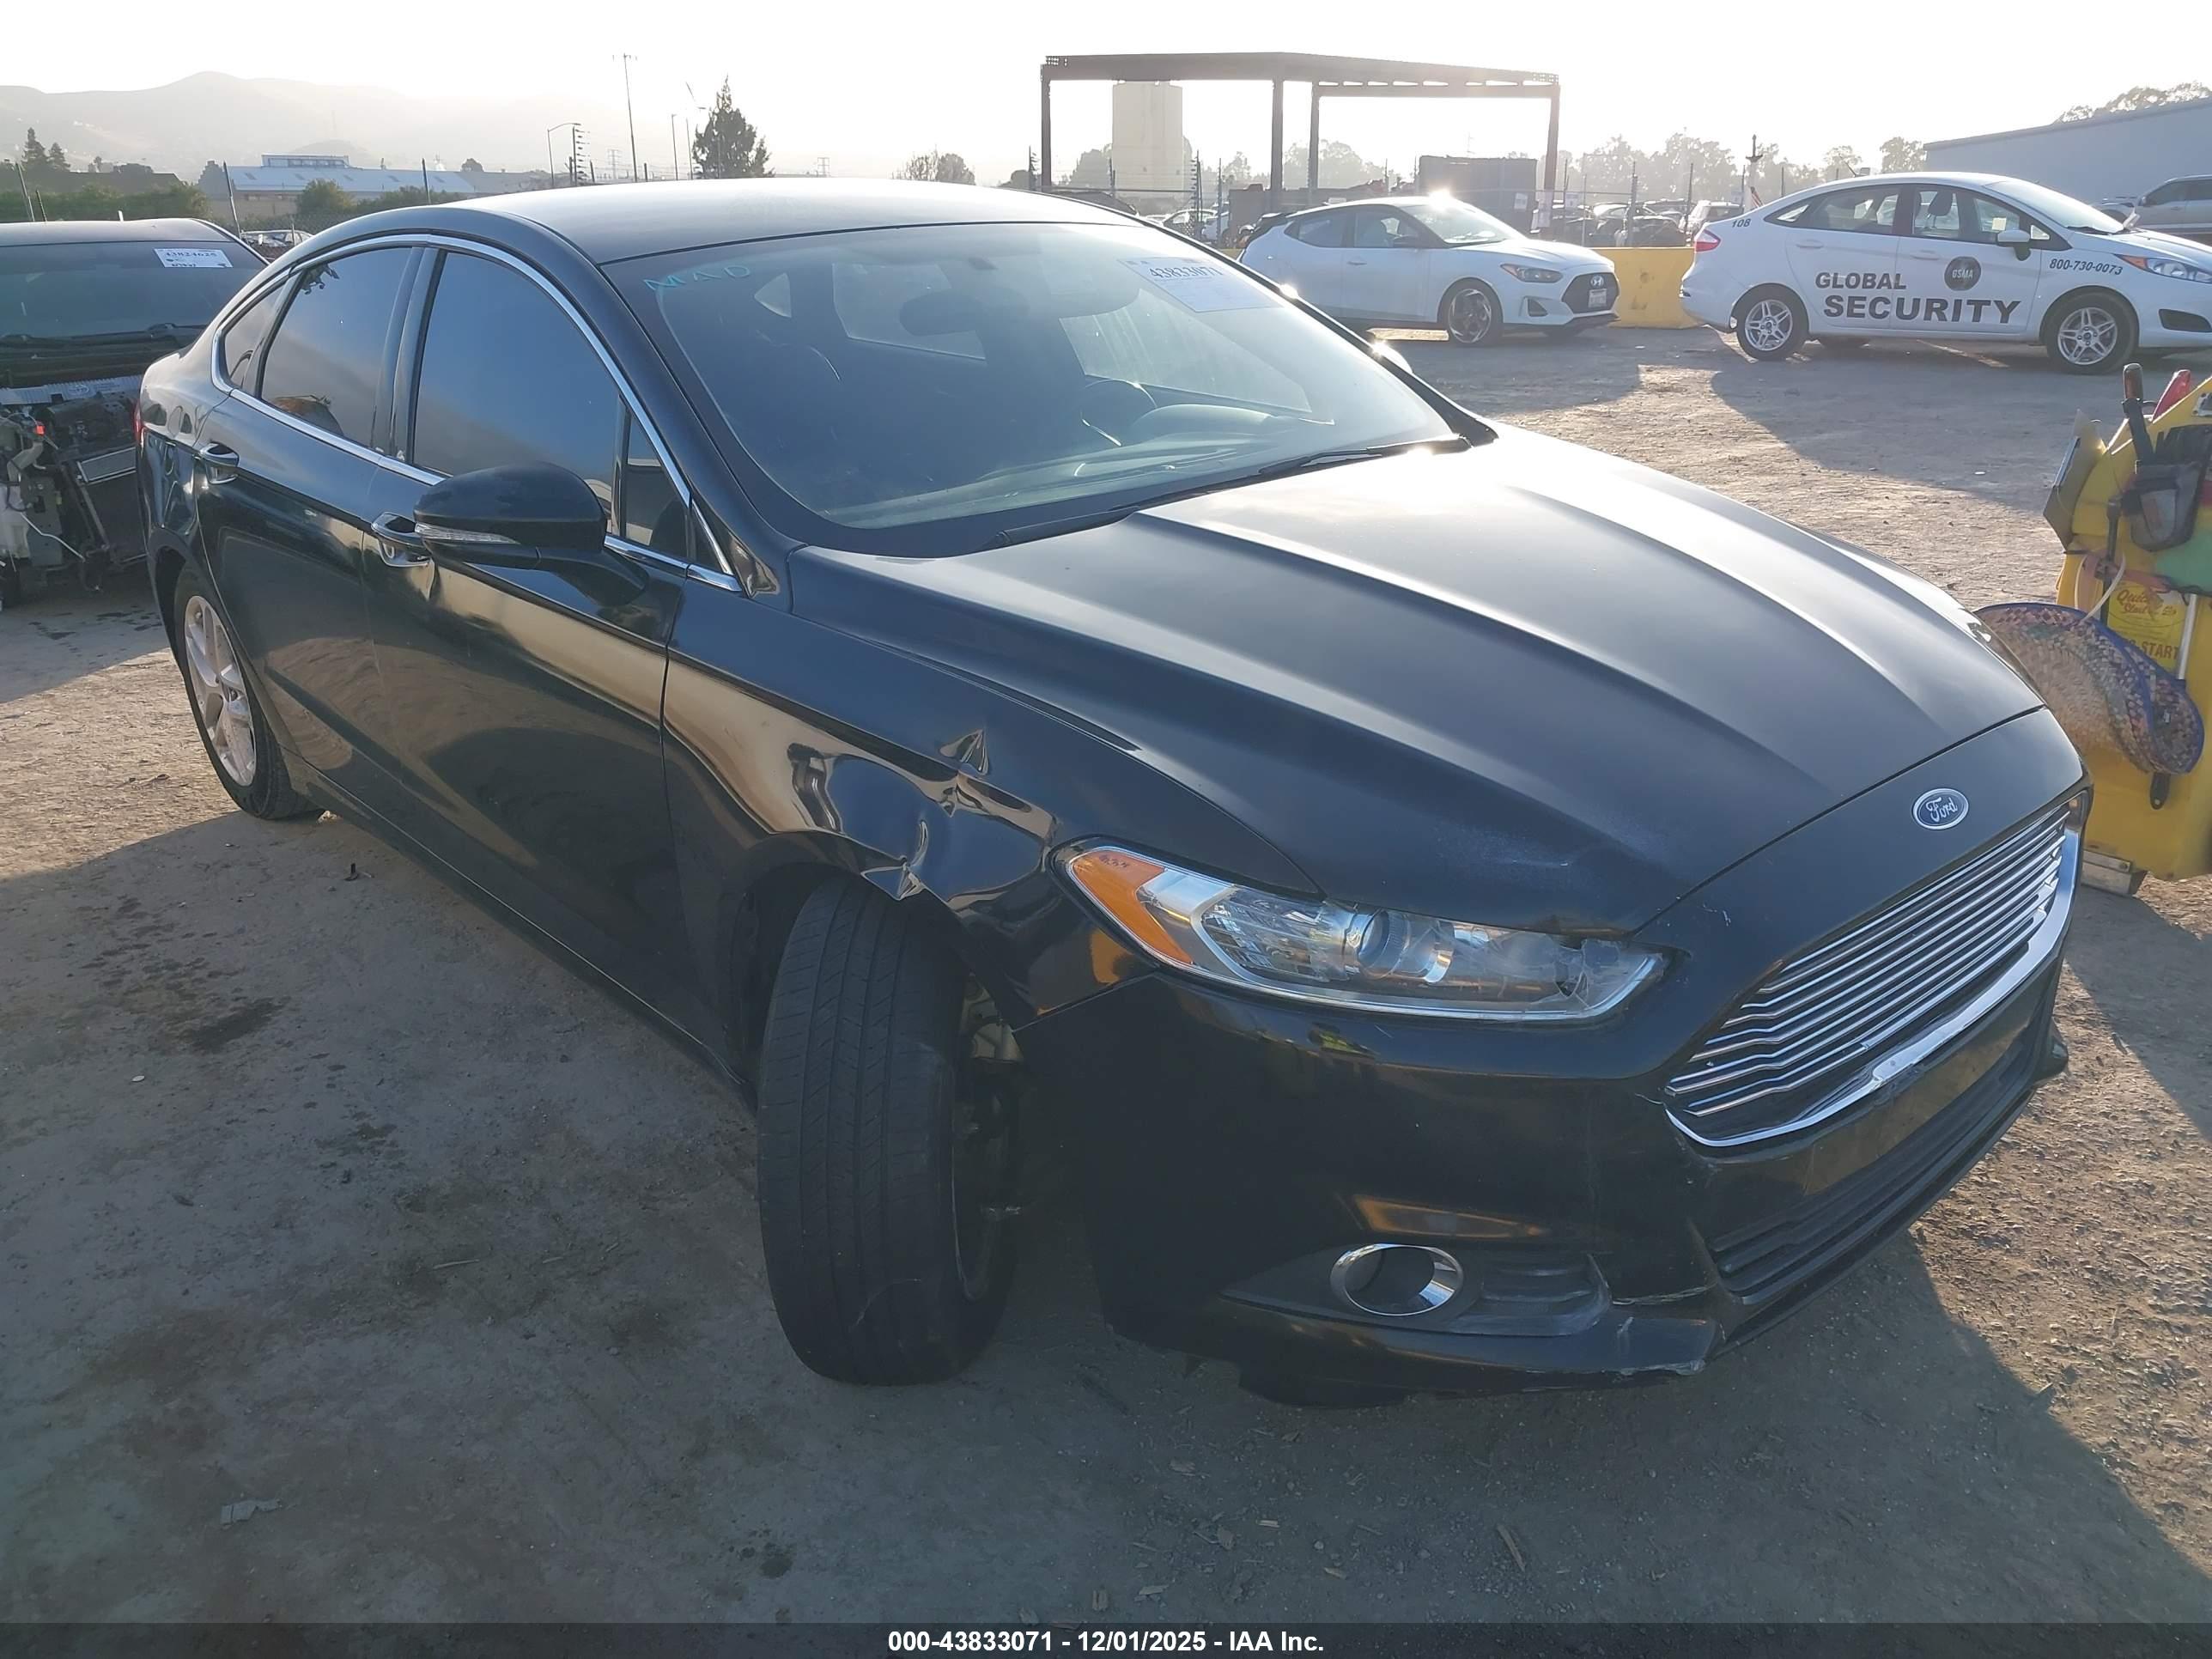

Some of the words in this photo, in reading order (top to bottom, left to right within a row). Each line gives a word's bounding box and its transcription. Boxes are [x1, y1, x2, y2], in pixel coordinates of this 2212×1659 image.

[1732, 218, 1752, 228] 108
[1149, 267, 1223, 278] 43833071
[2049, 258, 2124, 276] 800-730-0073
[1814, 271, 1907, 290] GLOBAL
[1823, 295, 2021, 325] SECURITY
[1925, 796, 1959, 823] Ford
